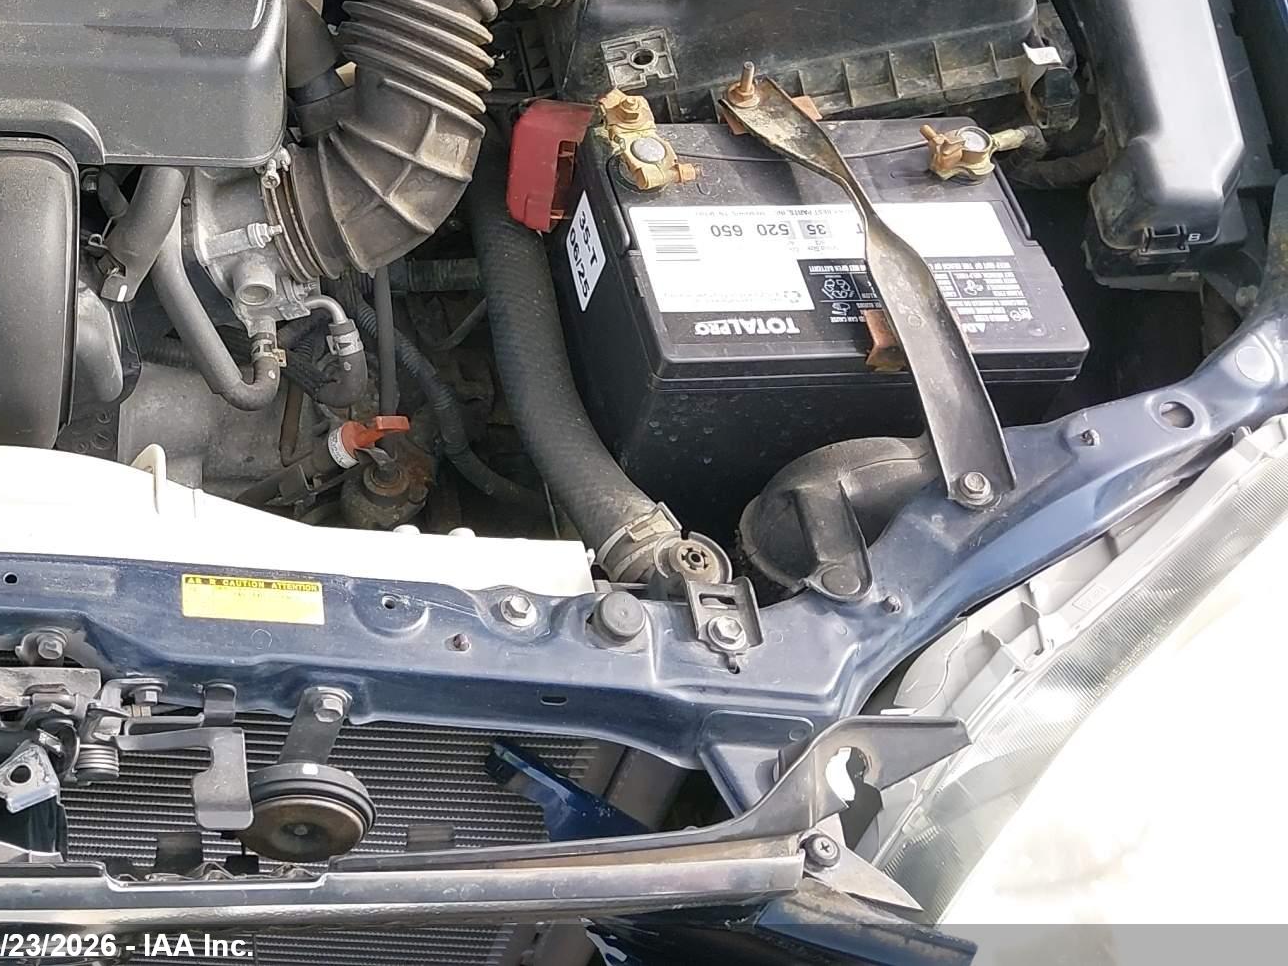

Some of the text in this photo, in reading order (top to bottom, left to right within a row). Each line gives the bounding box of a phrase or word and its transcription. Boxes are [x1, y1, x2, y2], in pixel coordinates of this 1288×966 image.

[578, 210, 599, 267] 35-T
[710, 223, 827, 237] 35 520 650
[568, 227, 591, 298] 06/25
[693, 316, 801, 337] TOTALPRO
[221, 578, 265, 588] CAUTION
[271, 581, 318, 592] ATTENTION
